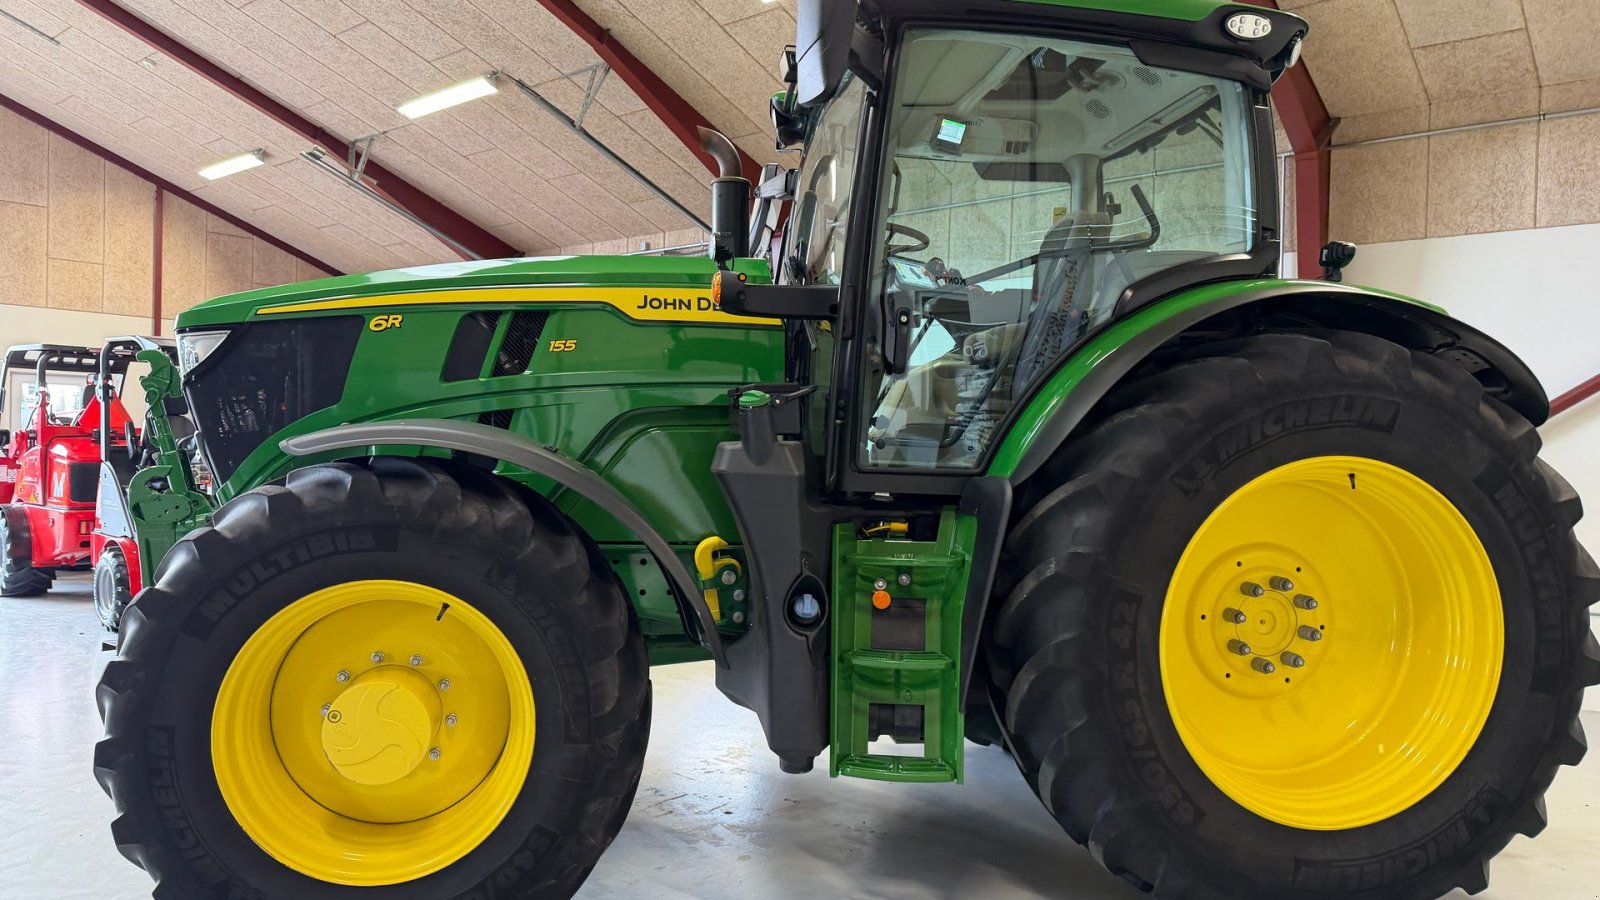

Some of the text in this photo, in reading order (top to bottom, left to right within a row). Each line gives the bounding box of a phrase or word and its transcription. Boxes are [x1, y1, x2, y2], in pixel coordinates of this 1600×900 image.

[369, 315, 402, 331] 6R
[637, 295, 691, 310] JOHN
[549, 340, 577, 352] 155
[1215, 398, 1396, 461] MICHELIN
[203, 529, 376, 621] MULTIBIB
[1494, 480, 1562, 668] MULTIBIB
[1110, 602, 1138, 650] 42
[1112, 660, 1136, 690] R
[149, 729, 230, 884] MICHELIN
[1294, 818, 1472, 890] MICHELIN
